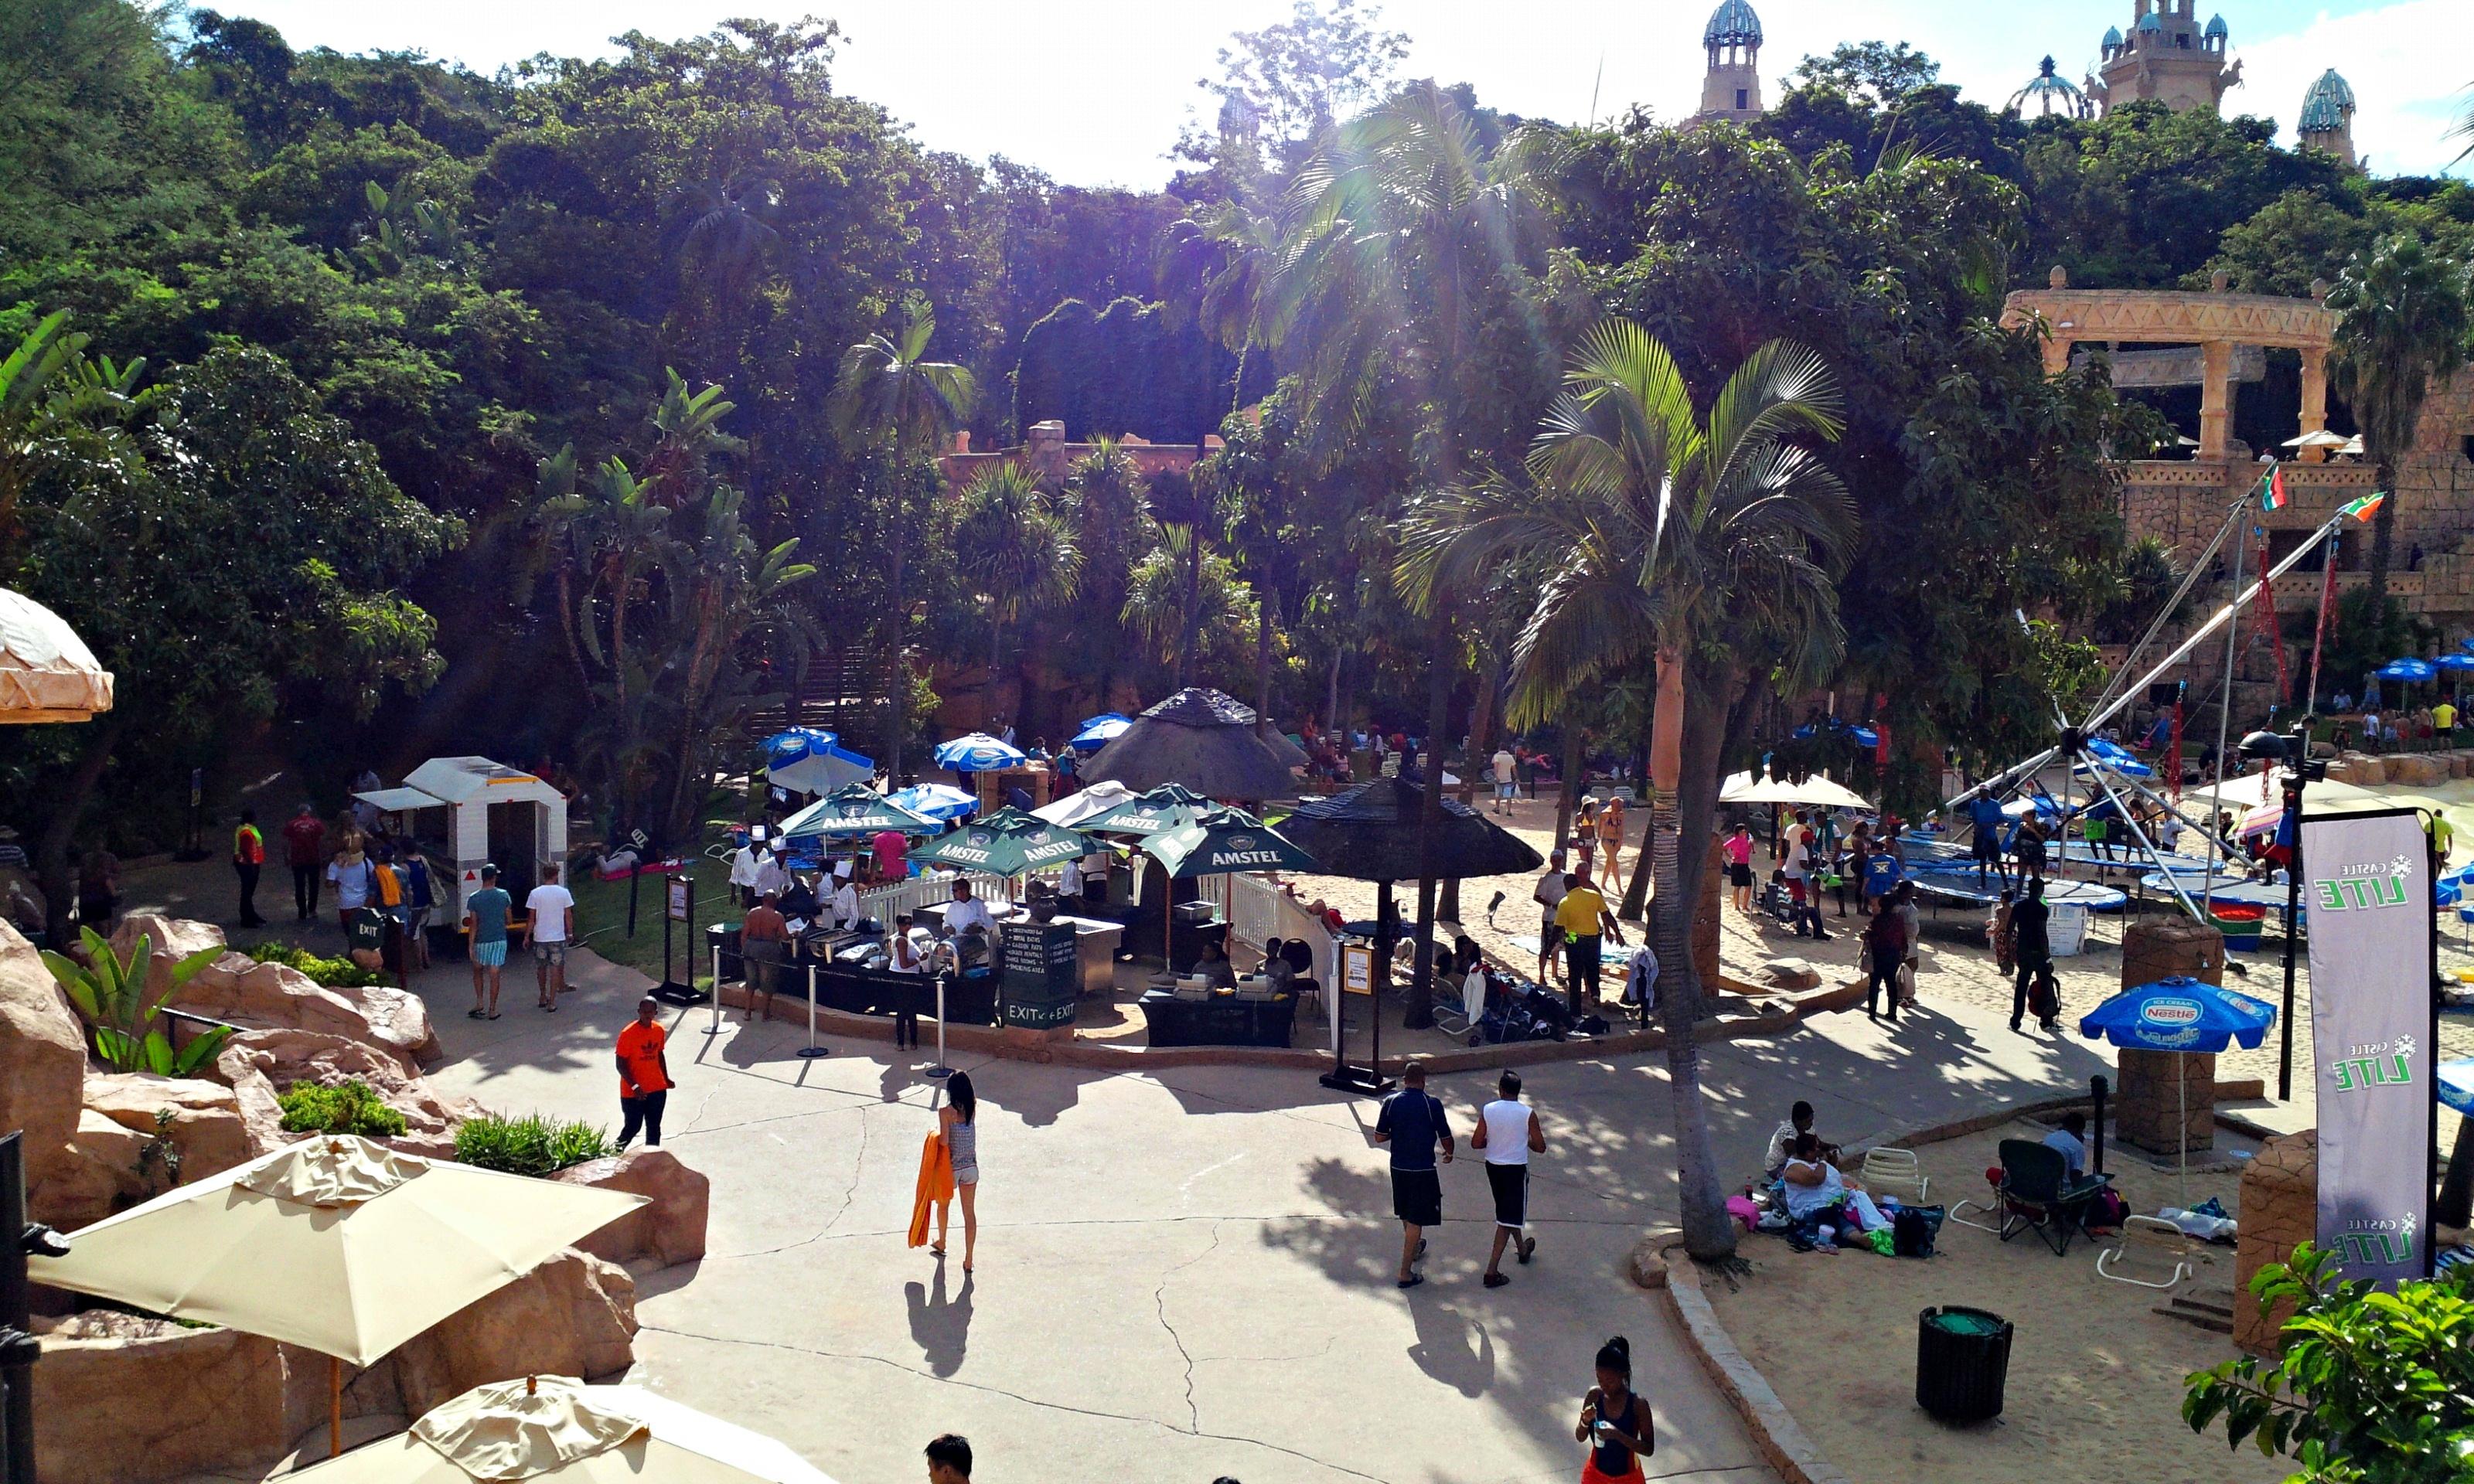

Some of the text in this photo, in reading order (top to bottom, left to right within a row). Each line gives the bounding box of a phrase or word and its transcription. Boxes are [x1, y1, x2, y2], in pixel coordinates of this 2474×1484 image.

[823, 816, 893, 829] AMSTEL
[1104, 814, 1163, 831] AMSTEL
[936, 843, 991, 863] AMSTEL
[1024, 839, 1080, 863] AMSTEL
[1211, 850, 1282, 866] AMSTEL
[359, 924, 378, 937] EXIT
[1009, 1004, 1038, 1021] EXIT
[1056, 1002, 1075, 1020] EXIT
